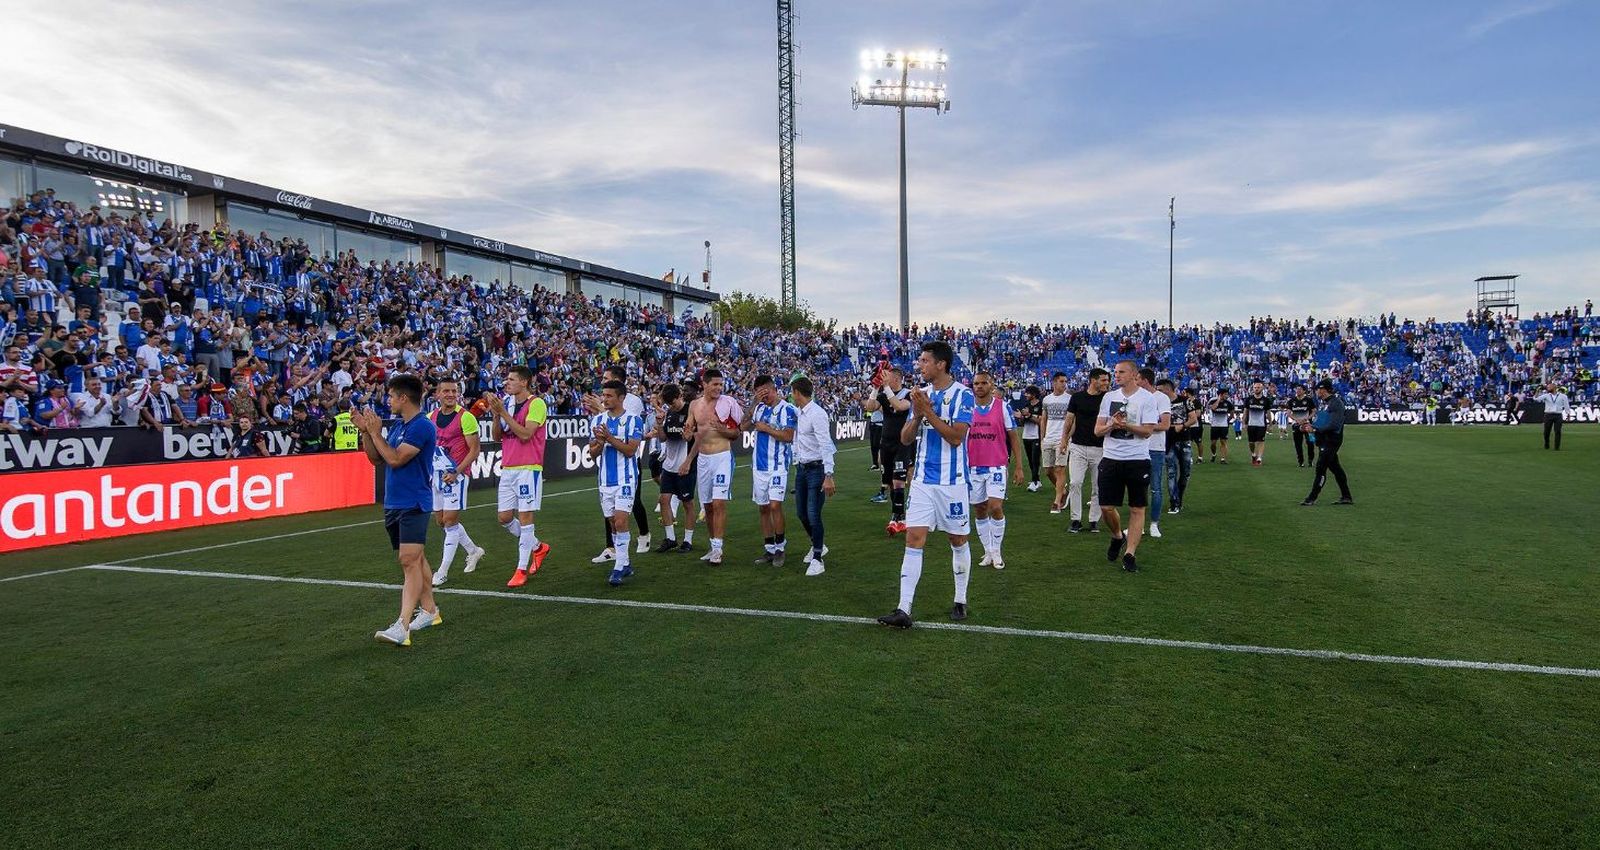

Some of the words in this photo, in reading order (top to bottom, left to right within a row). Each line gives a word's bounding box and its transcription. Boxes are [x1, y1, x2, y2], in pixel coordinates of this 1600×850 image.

[1357, 408, 1421, 425] betway
[836, 420, 867, 440] betway
[0, 465, 294, 540] antander
